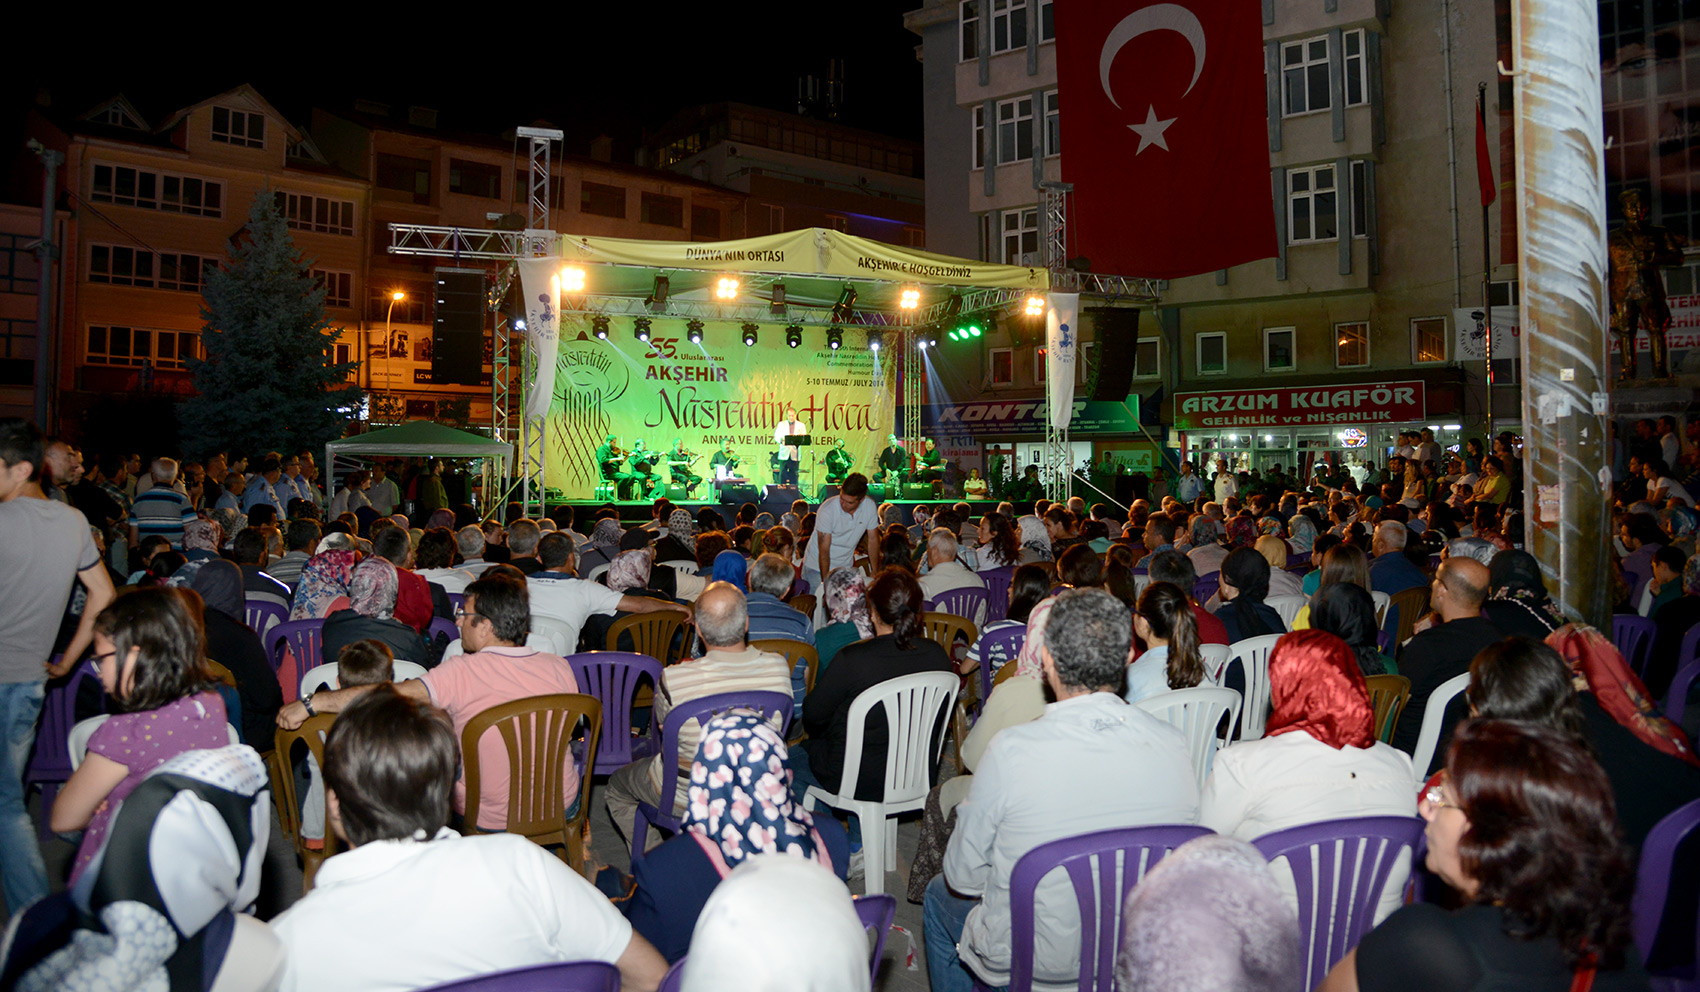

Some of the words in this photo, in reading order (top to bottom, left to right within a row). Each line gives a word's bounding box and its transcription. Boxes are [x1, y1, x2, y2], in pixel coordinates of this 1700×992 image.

[686, 247, 745, 261] DÜNYA'NIN
[747, 250, 784, 262] ORTASI
[858, 257, 907, 272] AKŞEHİR'E
[909, 263, 971, 278] HOŞGELDİNİZ
[681, 353, 724, 362] Uluslararası
[645, 363, 728, 385] AKŞEHİR
[806, 378, 820, 386] 5-10
[821, 378, 848, 386] TEMMUZ
[853, 379, 868, 387] JULY
[1182, 394, 1279, 414] ARZUM
[1291, 385, 1416, 408] KUAFÖR
[644, 386, 793, 430] Nasreddin
[796, 391, 882, 432] Hoca
[938, 402, 1087, 421] KONTR
[1202, 413, 1277, 426] GELİNLİK
[1282, 415, 1302, 423] ve
[1307, 411, 1391, 423] NİŞANLIK
[738, 435, 752, 445] VE
[942, 448, 979, 457] kiralama
